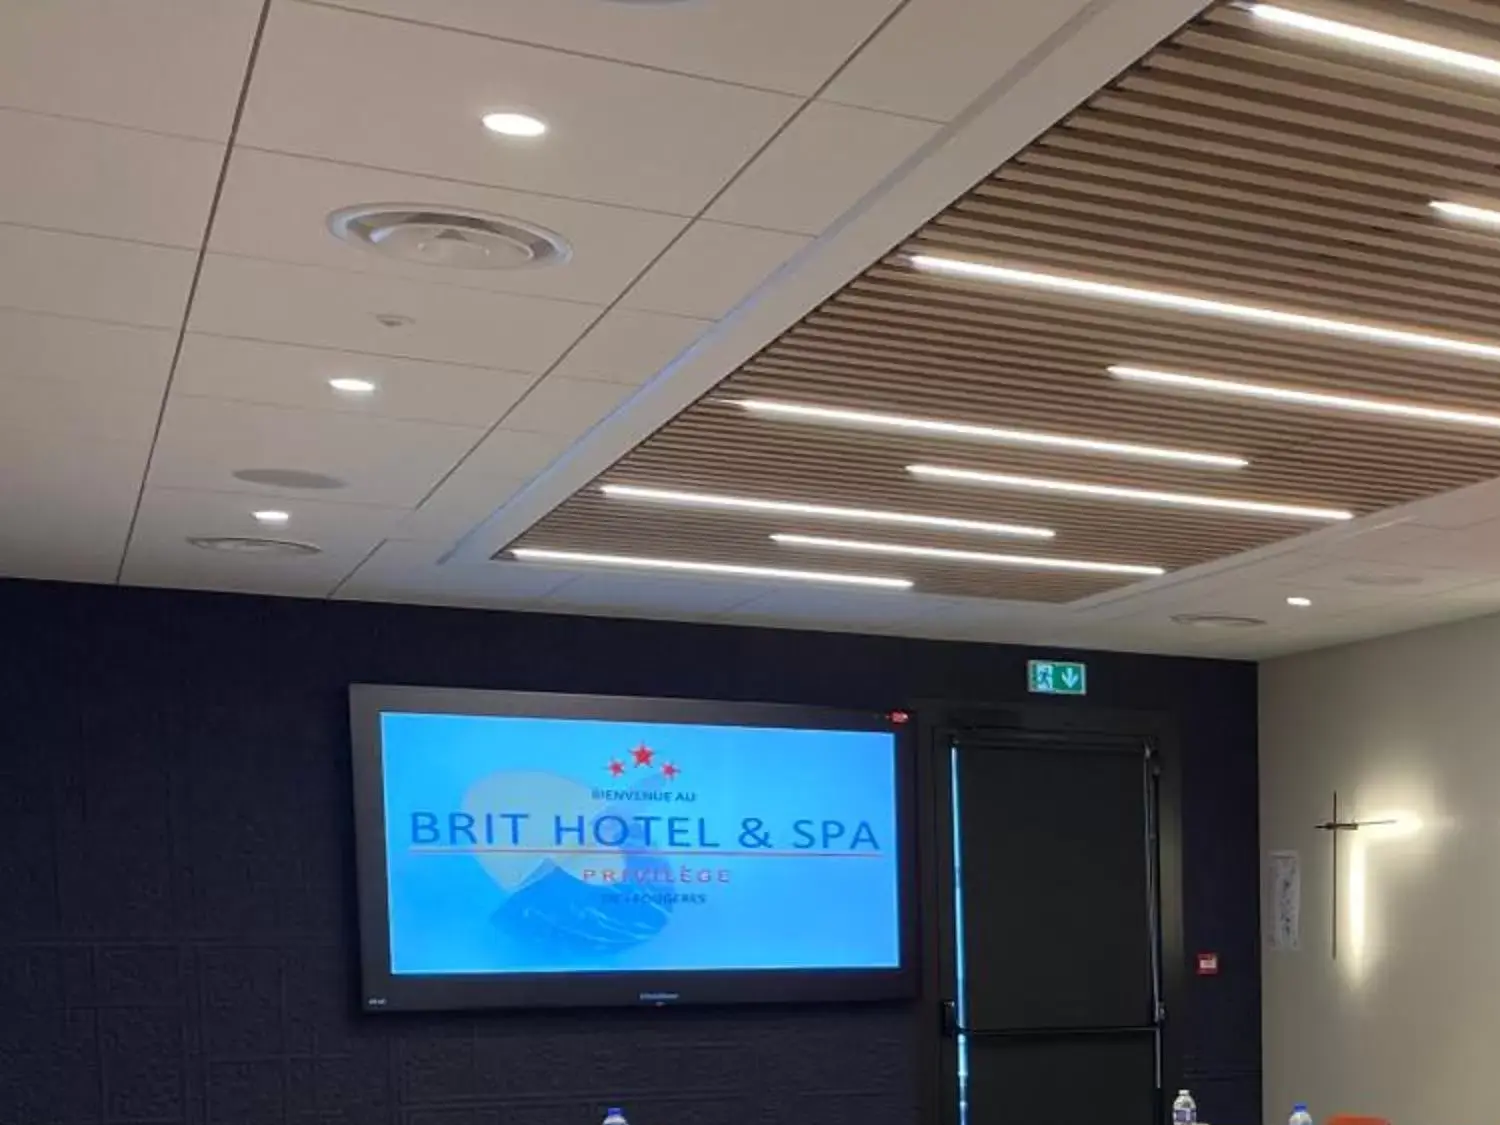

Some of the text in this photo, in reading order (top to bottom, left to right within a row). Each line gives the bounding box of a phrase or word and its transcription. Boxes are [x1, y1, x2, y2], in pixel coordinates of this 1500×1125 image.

[591, 789, 697, 803] BIENVENUE AU
[410, 811, 880, 850] BRIT HOTEL & SPA
[583, 864, 731, 884] PRIVILÈGE
